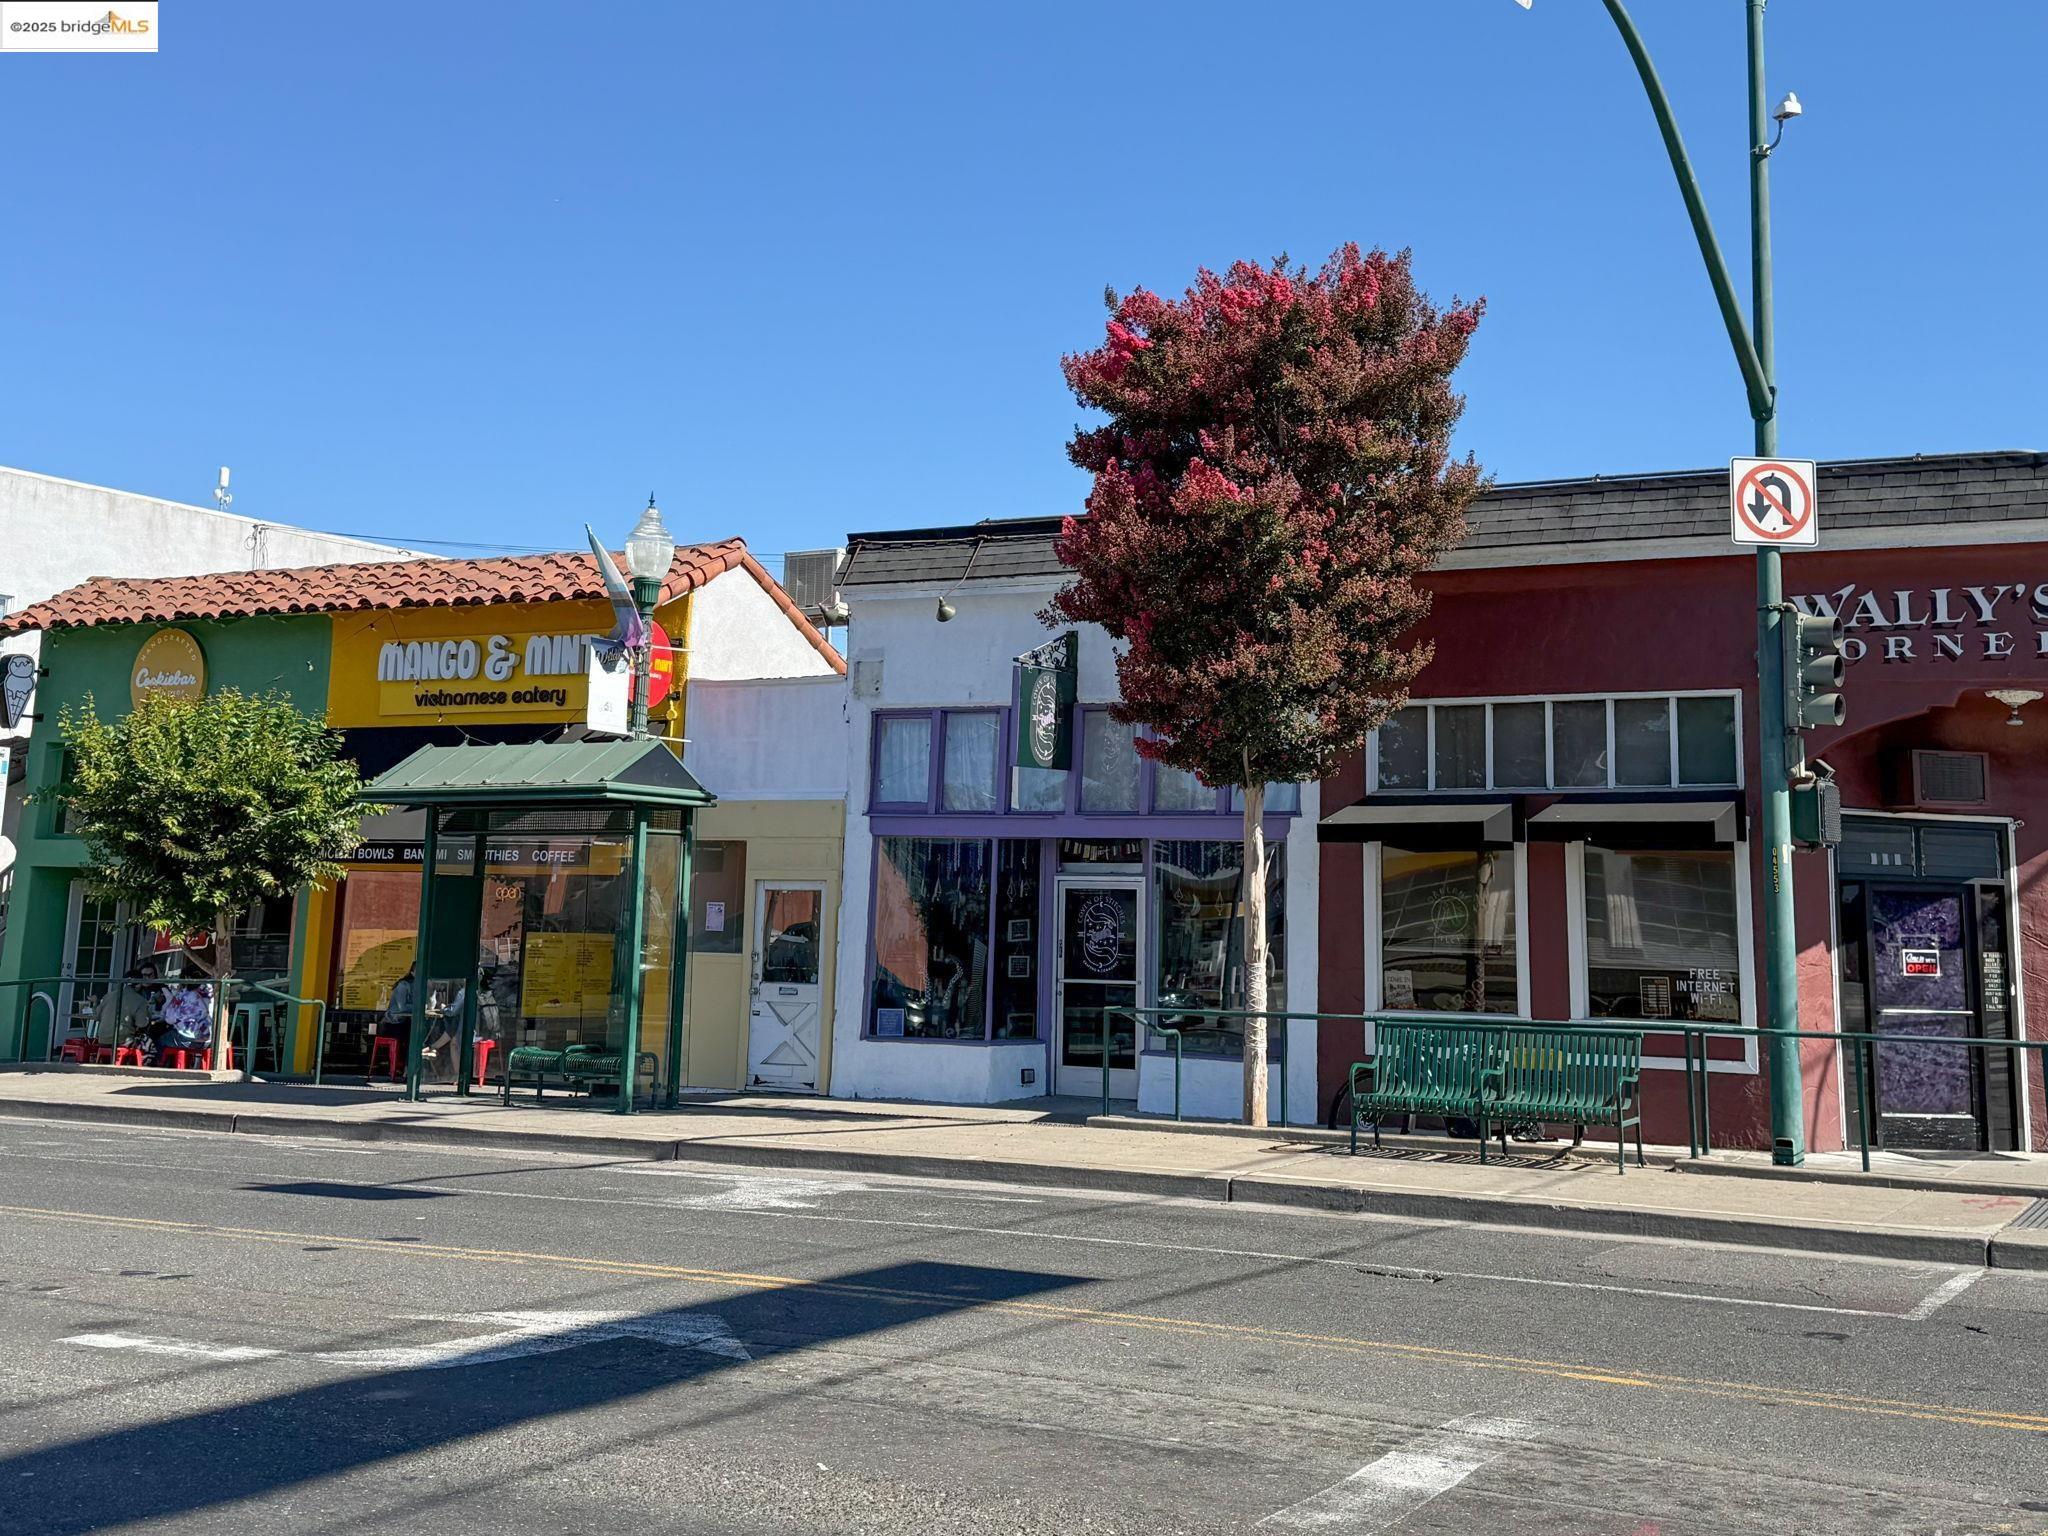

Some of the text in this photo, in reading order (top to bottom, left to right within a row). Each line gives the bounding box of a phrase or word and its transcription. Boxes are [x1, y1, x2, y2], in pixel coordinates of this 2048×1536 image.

[140, 634, 197, 662] HANDCRAFTED
[1840, 631, 2048, 660] ORNE
[378, 639, 481, 682] MANGO
[484, 635, 521, 682] &
[135, 667, 197, 688] Cookiebar
[414, 686, 567, 707] vietnamese eatery
[357, 848, 394, 860] BOWLS
[403, 848, 425, 860] BAN
[457, 849, 520, 861] SMTHIES
[531, 850, 576, 863] COFFEE
[1093, 895, 1104, 903] OF
[1689, 968, 1721, 980] FREE
[1907, 964, 1937, 973] OPEN
[1676, 980, 1735, 994] INTERNET
[1690, 992, 1722, 1005] Wi-Fi
